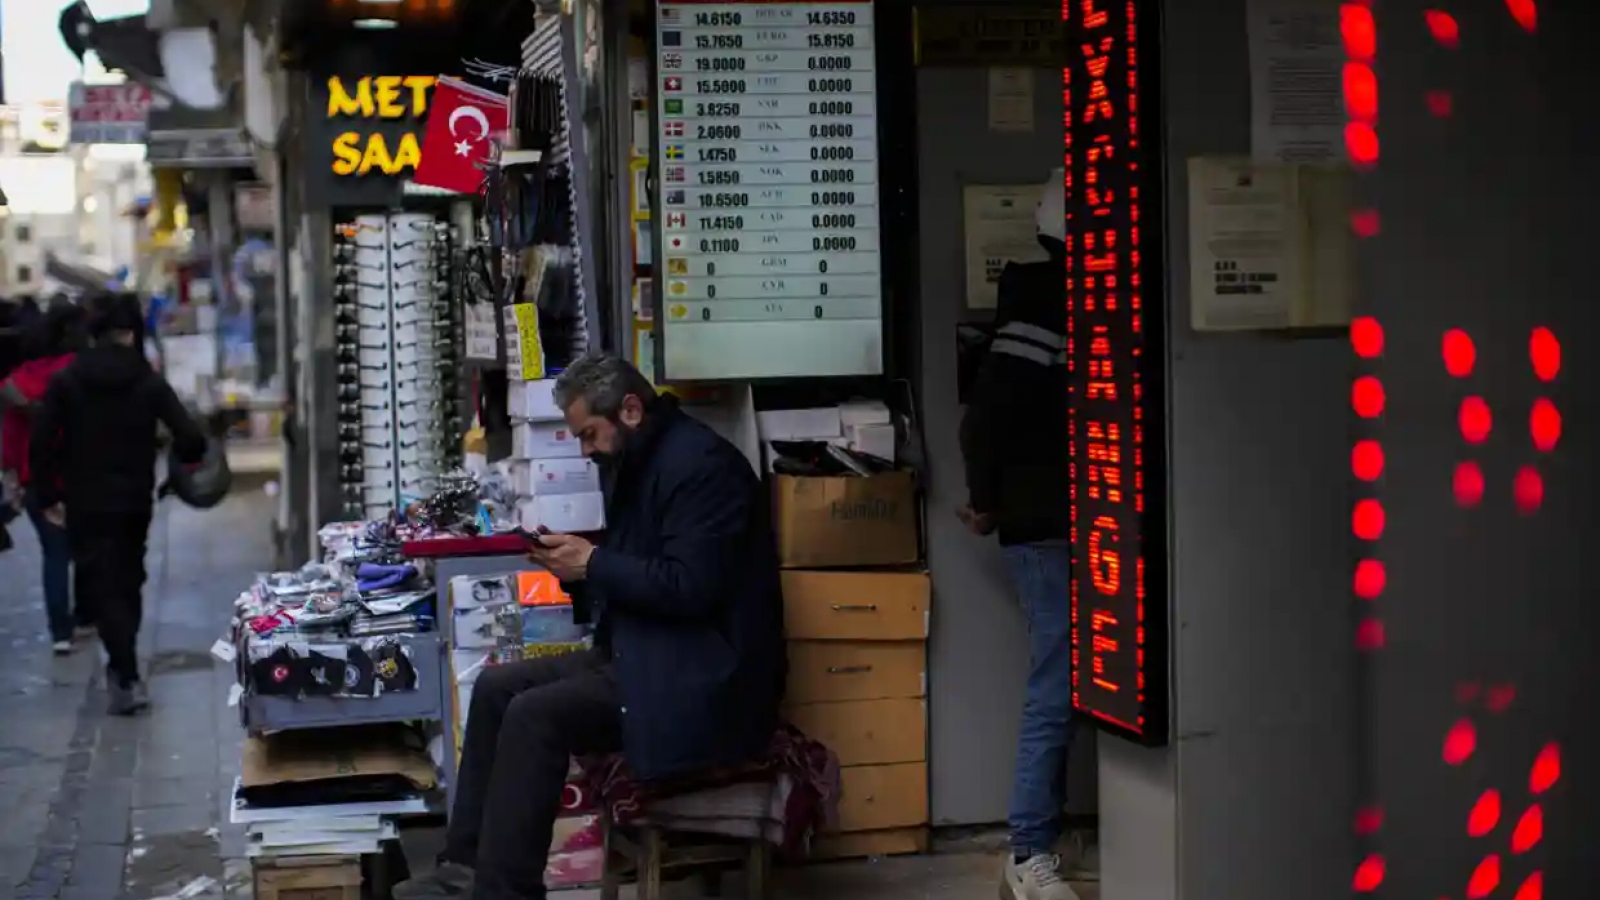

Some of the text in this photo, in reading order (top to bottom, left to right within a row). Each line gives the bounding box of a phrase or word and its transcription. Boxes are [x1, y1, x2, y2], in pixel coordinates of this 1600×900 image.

[695, 11, 741, 26] 14.6150
[806, 11, 855, 26] 14.6350
[695, 30, 854, 49] 15.7650 EURO 15.8150
[695, 57, 746, 71] 19.0000
[807, 56, 852, 71] 0.0000
[696, 79, 746, 94] 15.5000
[808, 78, 852, 93] 0.0000
[328, 75, 437, 118] MET
[696, 102, 740, 117] 3.8250
[808, 101, 853, 116] 0.0000
[697, 125, 741, 140] 2.0600
[809, 124, 853, 139] 0.0000
[698, 147, 737, 162] 1.4750
[810, 146, 854, 161] 0.0000
[698, 170, 740, 185] 1.5850
[810, 168, 854, 184] 0.0000
[699, 192, 749, 207] 10.6500
[811, 191, 855, 206] 0.0000
[699, 215, 744, 231] 11.4150
[812, 213, 856, 229] 0.0000
[700, 238, 740, 253] 0.1100
[812, 236, 856, 251] 0.0000
[706, 262, 716, 277] 0
[818, 259, 828, 274] 0
[707, 284, 717, 299] 0
[820, 282, 829, 296] 0
[702, 307, 712, 322] 0
[814, 305, 824, 320] 0
